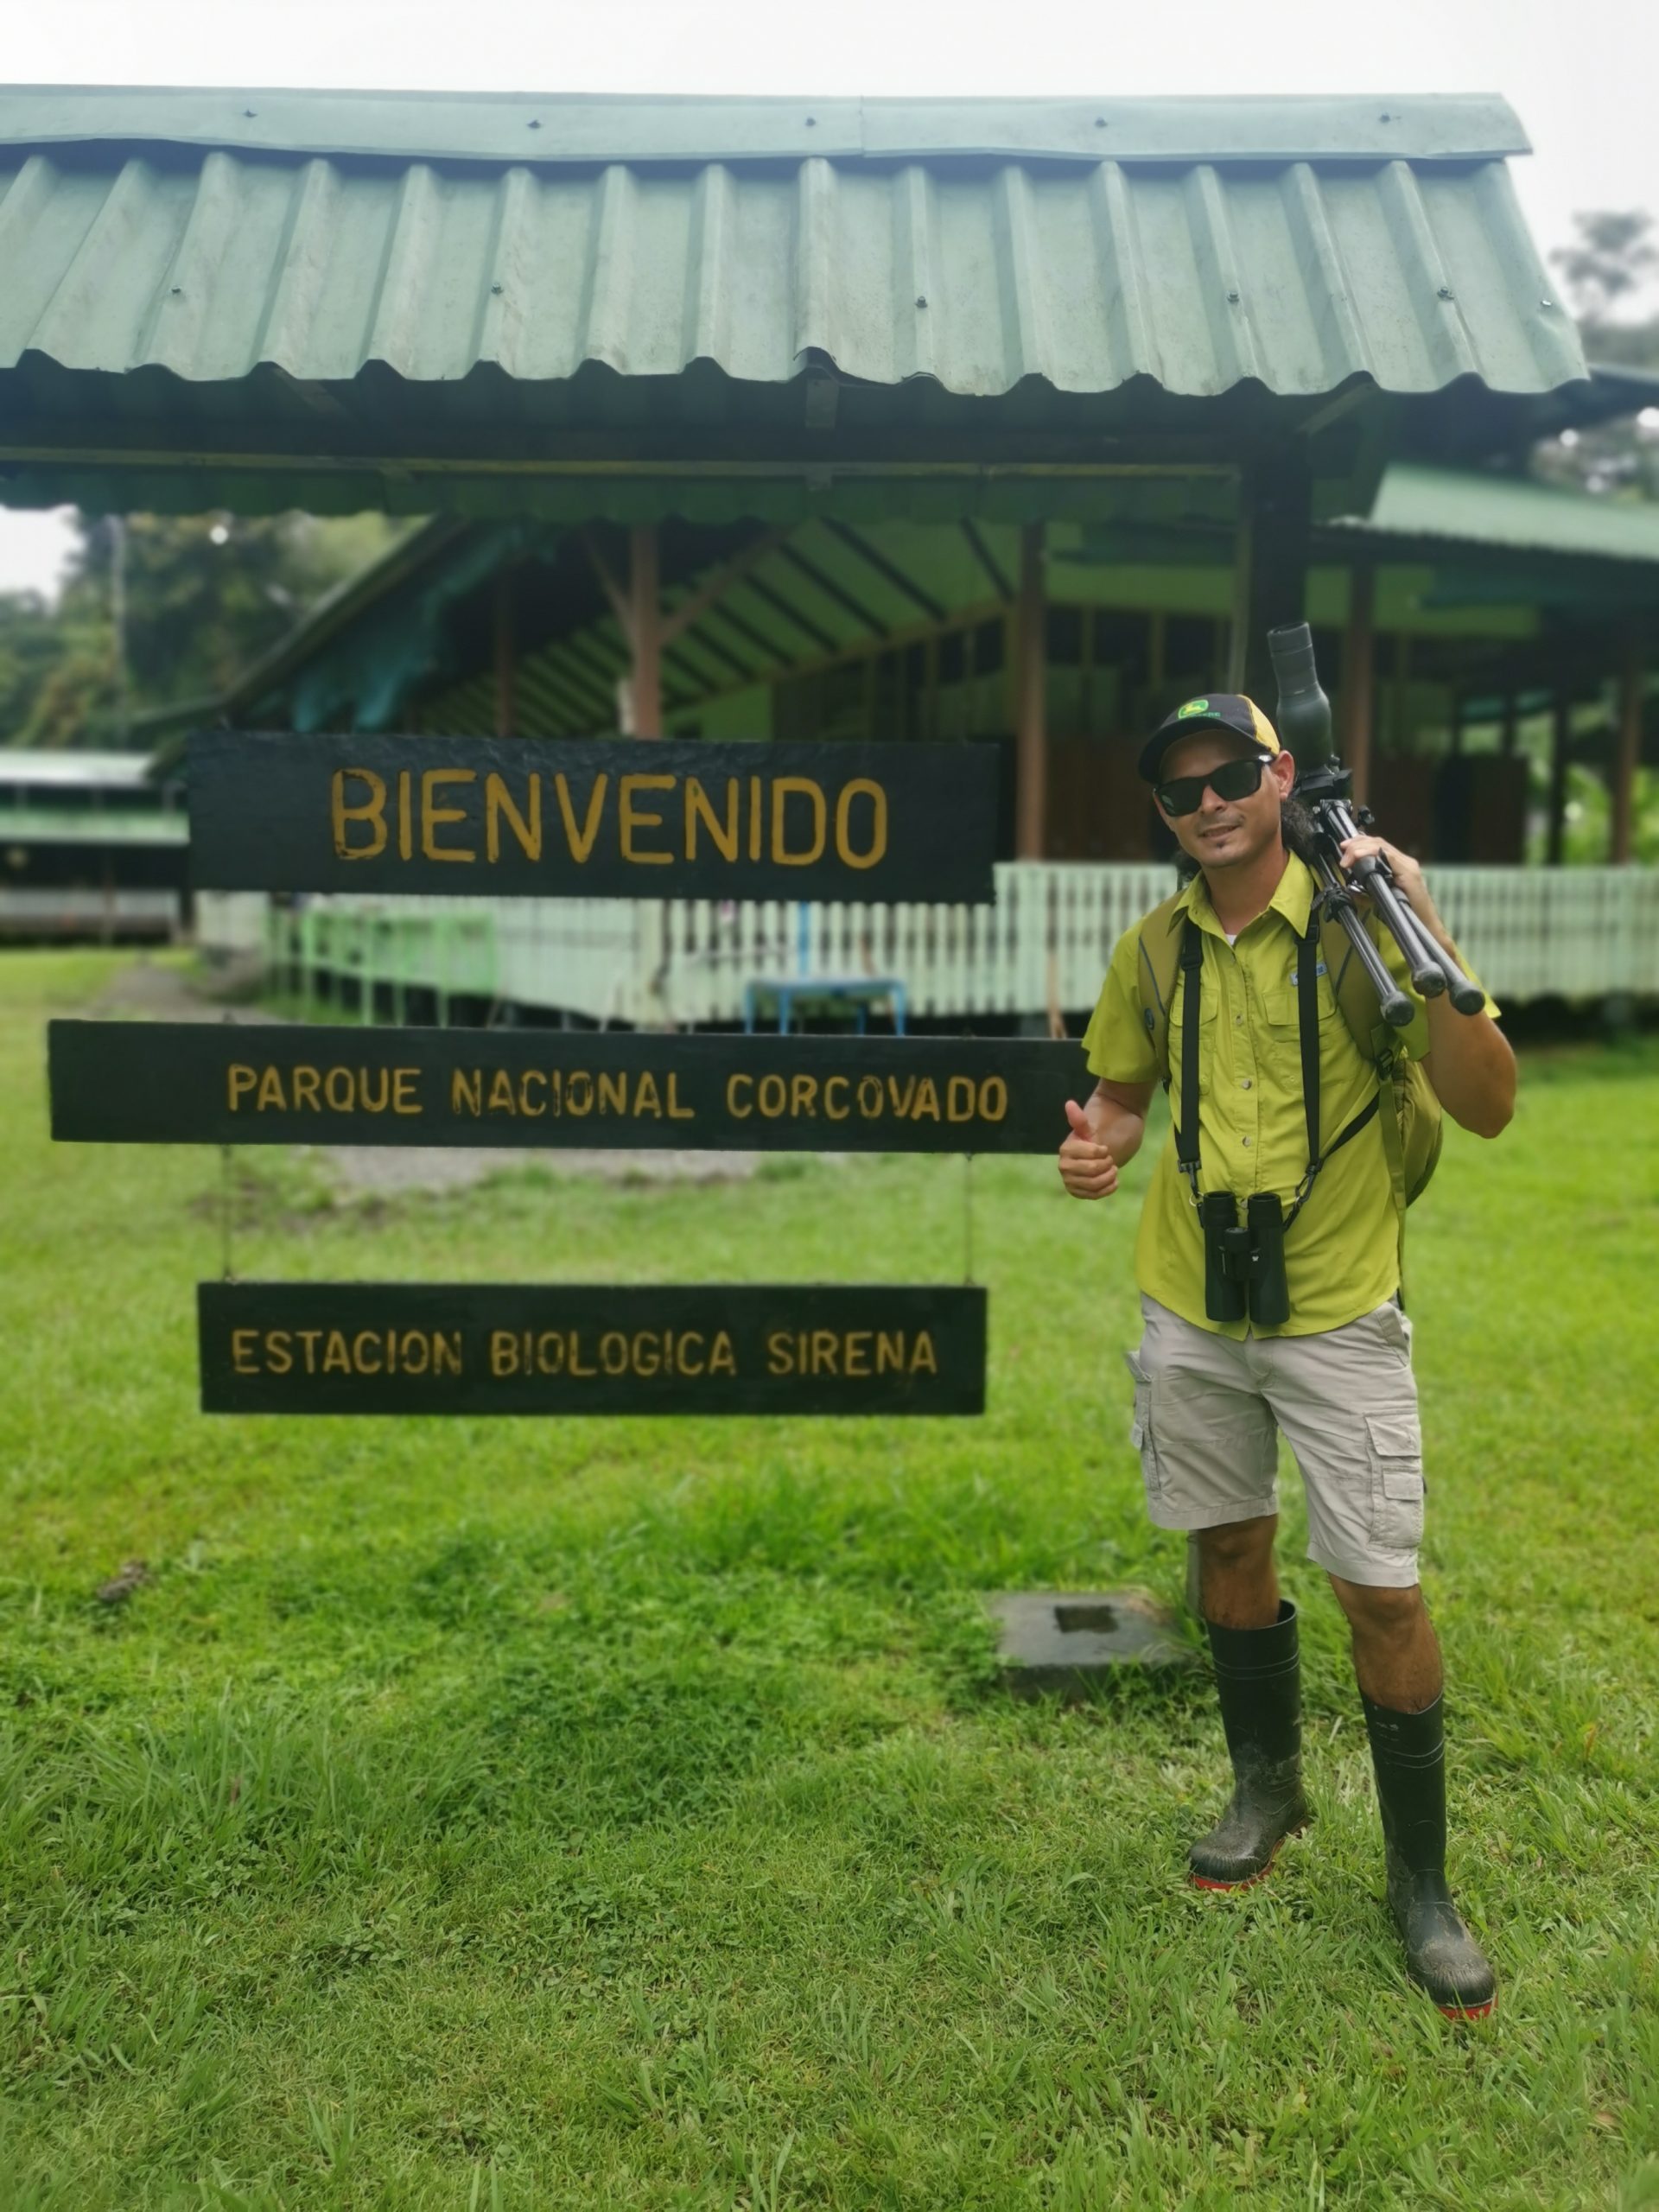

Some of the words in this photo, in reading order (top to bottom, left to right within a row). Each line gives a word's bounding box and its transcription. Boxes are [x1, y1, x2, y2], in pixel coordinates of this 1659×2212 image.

[331, 769, 888, 869] BIENVENIDO
[227, 1064, 423, 1114] PARQUE
[452, 1070, 695, 1119] NACIONAL
[726, 1074, 1008, 1122] CORCOVADO
[232, 1328, 463, 1376] ESTACION
[491, 1331, 736, 1376] BIOLOGICA
[768, 1331, 938, 1376] SIRENA
